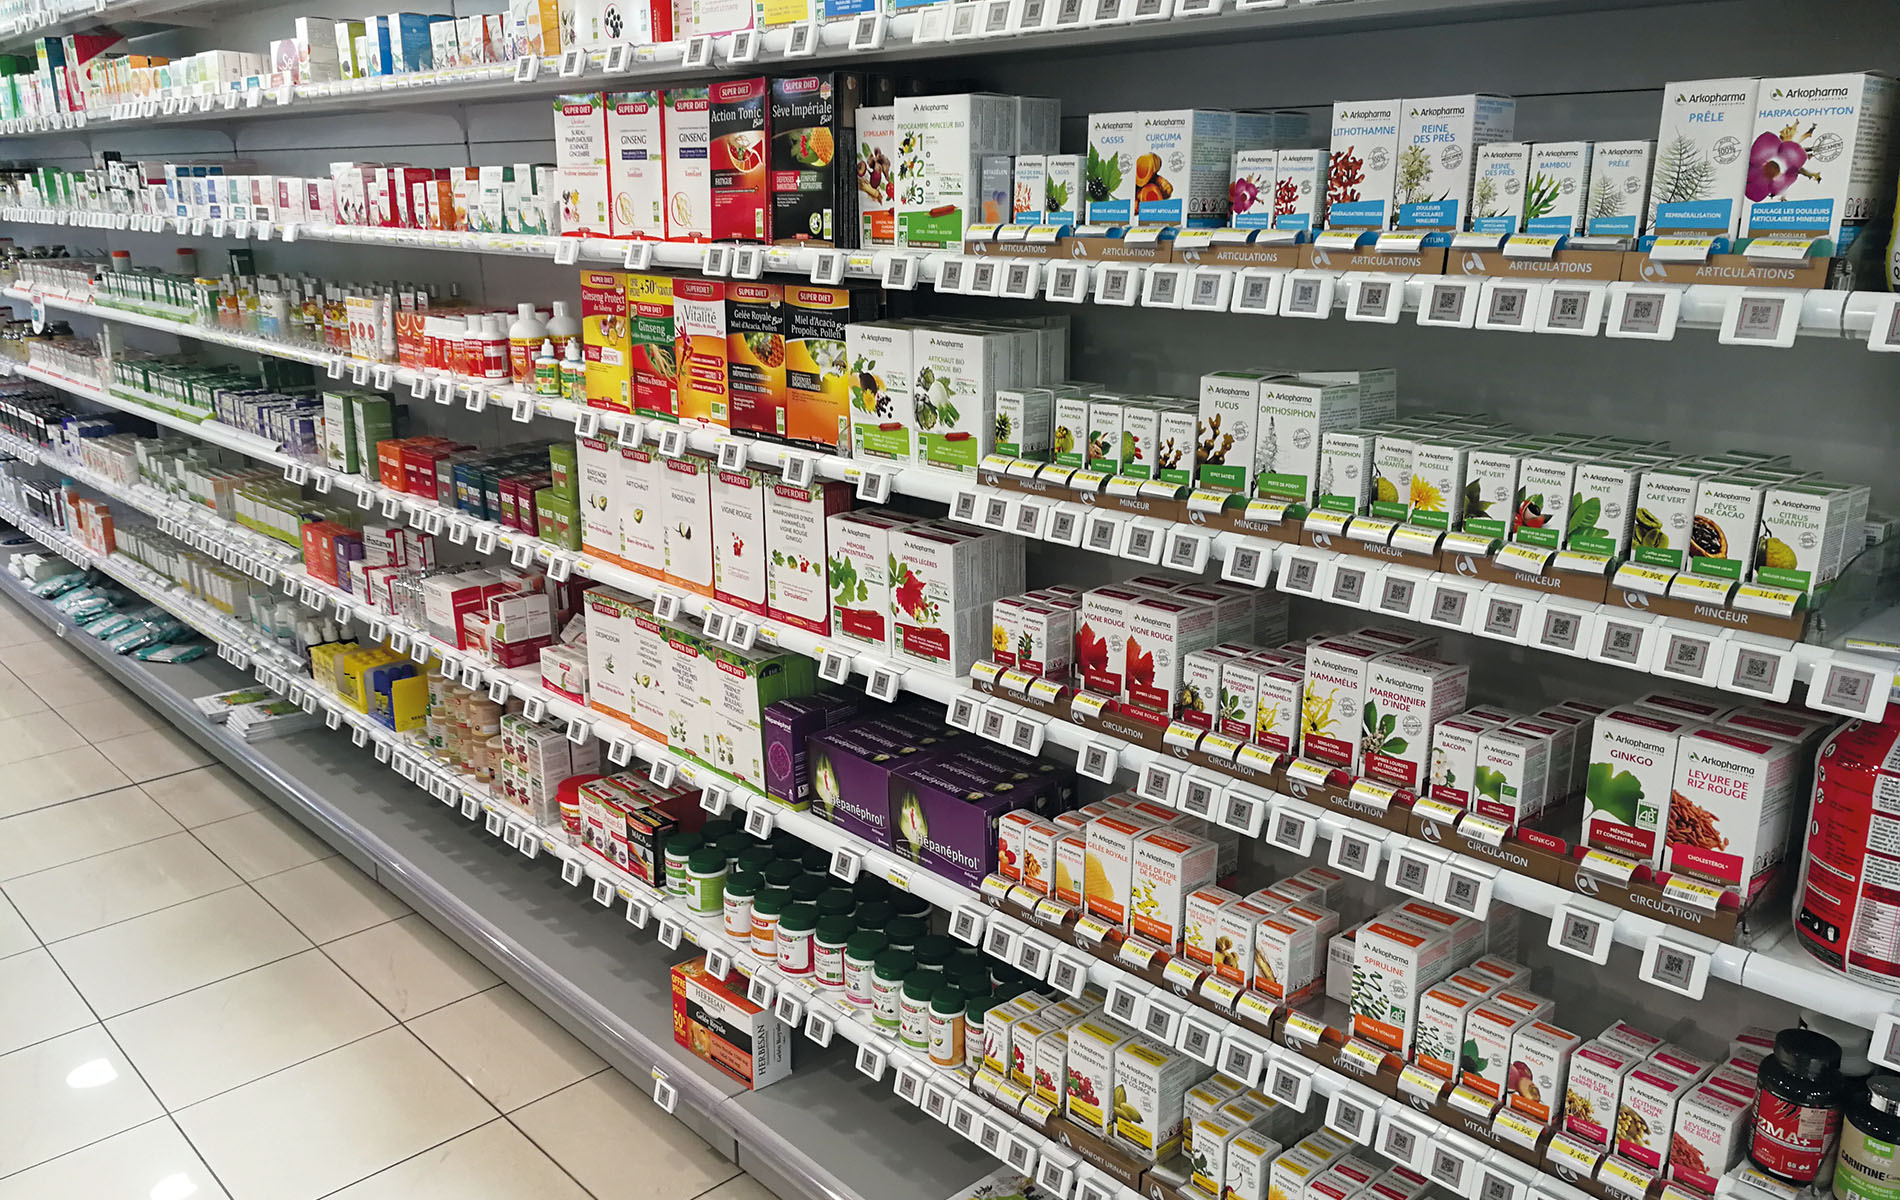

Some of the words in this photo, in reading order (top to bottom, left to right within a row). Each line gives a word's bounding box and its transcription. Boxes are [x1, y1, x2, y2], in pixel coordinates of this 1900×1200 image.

[1689, 92, 1746, 105] Arkopharma
[1786, 87, 1848, 100] Arkopharma
[711, 110, 736, 122] Action
[738, 107, 762, 120] Tonic
[772, 104, 790, 118] Sève
[792, 100, 832, 118] Impériale
[1350, 110, 1392, 121] Arkopharma
[1420, 106, 1466, 118] Arkopharma
[1688, 111, 1725, 122] PRÊLE
[1759, 106, 1854, 118] HARPAGOPHYTON
[820, 114, 833, 125] Bio
[897, 122, 928, 130] PROGRAMME
[1152, 118, 1186, 128] Arkopharma
[1333, 126, 1396, 136] LITHOTHAMNE
[1421, 124, 1449, 134] REINE
[620, 136, 647, 144] GINSENG
[679, 132, 708, 143] GINSENG
[1100, 136, 1125, 145] CASSIS
[1146, 133, 1182, 142] CURCUMA
[1150, 141, 1176, 150] pipérine
[916, 160, 924, 178] 2
[1608, 160, 1630, 168] PRÊLE
[999, 243, 1047, 254] ARTICULATIONS
[1101, 246, 1156, 258] ARTICULATIONS
[1216, 251, 1278, 263] ARTICULATIONS
[1350, 255, 1422, 268] ARTICULATIONS
[1508, 260, 1594, 274] ARTICULATIONS
[1696, 266, 1796, 280] ARTICULATIONS
[582, 290, 604, 304] Ginseng
[604, 292, 625, 304] Protect
[800, 292, 818, 302] SUPER
[818, 294, 832, 302] DIET
[683, 304, 717, 324] Vitalité
[734, 309, 750, 320] Gelée
[751, 311, 772, 323] Royale
[638, 321, 665, 336] Ginseng
[794, 314, 808, 326] Miel
[809, 316, 836, 330] d'Acacia
[791, 324, 819, 338] Propolis,
[820, 328, 842, 341] Pollen
[928, 355, 955, 365] ARTICHAUT
[955, 358, 965, 366] BIO
[932, 364, 952, 373] FENOUIL
[952, 366, 962, 374] BIO
[1215, 386, 1250, 398] Arkopharma
[1275, 392, 1312, 405] Arkopharma
[1214, 400, 1240, 411] FUCUS
[1260, 405, 1316, 420] ORTHOSIPHON
[584, 438, 606, 452] SUPERDIET
[622, 449, 648, 463] SUPERDIET
[1322, 448, 1362, 459] ORTHOSIPHON
[1384, 456, 1405, 464] CITRUS
[668, 460, 696, 475] SUPERDIET
[1420, 462, 1450, 472] PILOSELLE
[1476, 469, 1487, 477] THÉ
[1488, 470, 1505, 480] VERT
[720, 472, 750, 488] SUPERDIET
[1020, 480, 1047, 492] MINCEUR
[1527, 476, 1562, 488] GUARANA
[775, 486, 810, 501] SUPERDIET
[1590, 484, 1612, 494] MATÉ
[1654, 483, 1691, 494] Arkopharma
[1120, 498, 1150, 511] MINCEUR
[1646, 494, 1662, 503] CAFÉ
[1664, 496, 1687, 506] VERT
[1713, 492, 1752, 504] Arkopharma
[720, 506, 736, 518] VIGNE
[736, 510, 752, 521] ROUGE
[1780, 500, 1822, 513] Arkopharma
[1704, 508, 1714, 517] DE
[1716, 511, 1746, 521] CACAO
[1778, 512, 1808, 523] CITRUS
[1233, 518, 1270, 534] MINCEUR
[1766, 517, 1819, 531] AURANTIUM
[838, 547, 874, 562] CONCENTRATION
[1363, 542, 1403, 558] MINCEUR
[902, 554, 917, 566] JAMBES
[916, 558, 938, 570] LÉGÈRES
[1515, 572, 1561, 588] MINCEUR
[1759, 591, 1788, 602] 11,40€
[593, 604, 620, 618] SUPERDIET
[1694, 606, 1750, 626] MINCEUR
[636, 620, 660, 634] SUPERDIET
[1084, 612, 1103, 624] VIGNE
[1103, 617, 1125, 630] ROUGE
[1129, 626, 1150, 637] VIGNE
[1150, 630, 1174, 644] ROUGE
[1321, 660, 1358, 677] Arkopharma
[1310, 671, 1359, 691] HAMAMÉLIS
[1384, 676, 1424, 694] Arkopharma
[1008, 690, 1045, 709] CIRCULATION
[1261, 690, 1292, 706] HAMAMÉLIS
[1369, 687, 1427, 709] MARRONNIER
[1382, 698, 1412, 714] D'INDE
[1102, 720, 1144, 741] CIRCULATION
[1442, 742, 1467, 754] BACOPA
[1615, 735, 1666, 756] Arkopharma
[1208, 756, 1256, 778] CIRCULATION
[1487, 755, 1513, 769] GINKGO
[1610, 750, 1654, 770] GINKGO
[1701, 756, 1755, 778] Arkopharma
[1688, 770, 1730, 788] LEVURE
[1733, 781, 1750, 793] DE
[1686, 778, 1705, 791] RIZ
[1707, 784, 1749, 803] ROUGE
[830, 794, 884, 828] Hépanéphrol
[1330, 794, 1385, 820] CIRCULATION
[1596, 830, 1603, 838] ET
[1602, 832, 1648, 850] CONCENTRATION
[1610, 827, 1634, 840] MÉMOIRE
[1528, 834, 1556, 850] GINKGO
[917, 834, 979, 872] Hépanéphrol
[1088, 841, 1105, 854] GELÉE
[1105, 848, 1129, 864] ROYALE
[1467, 840, 1529, 868] CIRCULATION
[1136, 861, 1153, 874] HUILE
[1153, 868, 1163, 876] DE
[1162, 870, 1177, 882] FOIE
[1140, 869, 1149, 879] DE
[1148, 872, 1172, 888] MORUE
[1629, 894, 1702, 924] CIRCULATION
[1372, 946, 1409, 966] Arkopharma
[1364, 956, 1405, 978] SPIRULINE
[672, 974, 686, 987] OFFRE
[695, 988, 727, 1012] HERBESAN
[1214, 1002, 1242, 1020] VITALITÉ
[696, 1010, 710, 1026] Gelée
[710, 1018, 727, 1036] Royale
[756, 1024, 770, 1076] HERBESAN
[1332, 1060, 1364, 1078] VITALITÉ
[1525, 1055, 1545, 1068] MACA
[1629, 1096, 1664, 1118] LÉCITHINE
[1463, 1118, 1502, 1144] VITALITÉ
[1684, 1127, 1695, 1137] RIZ
[1694, 1131, 1722, 1148] ROUGE
[1757, 1116, 1811, 1148] ZMA+
[1078, 1146, 1105, 1166] CONFORT
[1104, 1160, 1132, 1180] URINAIRE
[1568, 1150, 1589, 1165] 9,40€
[1841, 1150, 1886, 1182] CARNITINE
[1622, 1172, 1644, 1187] 9,60€
